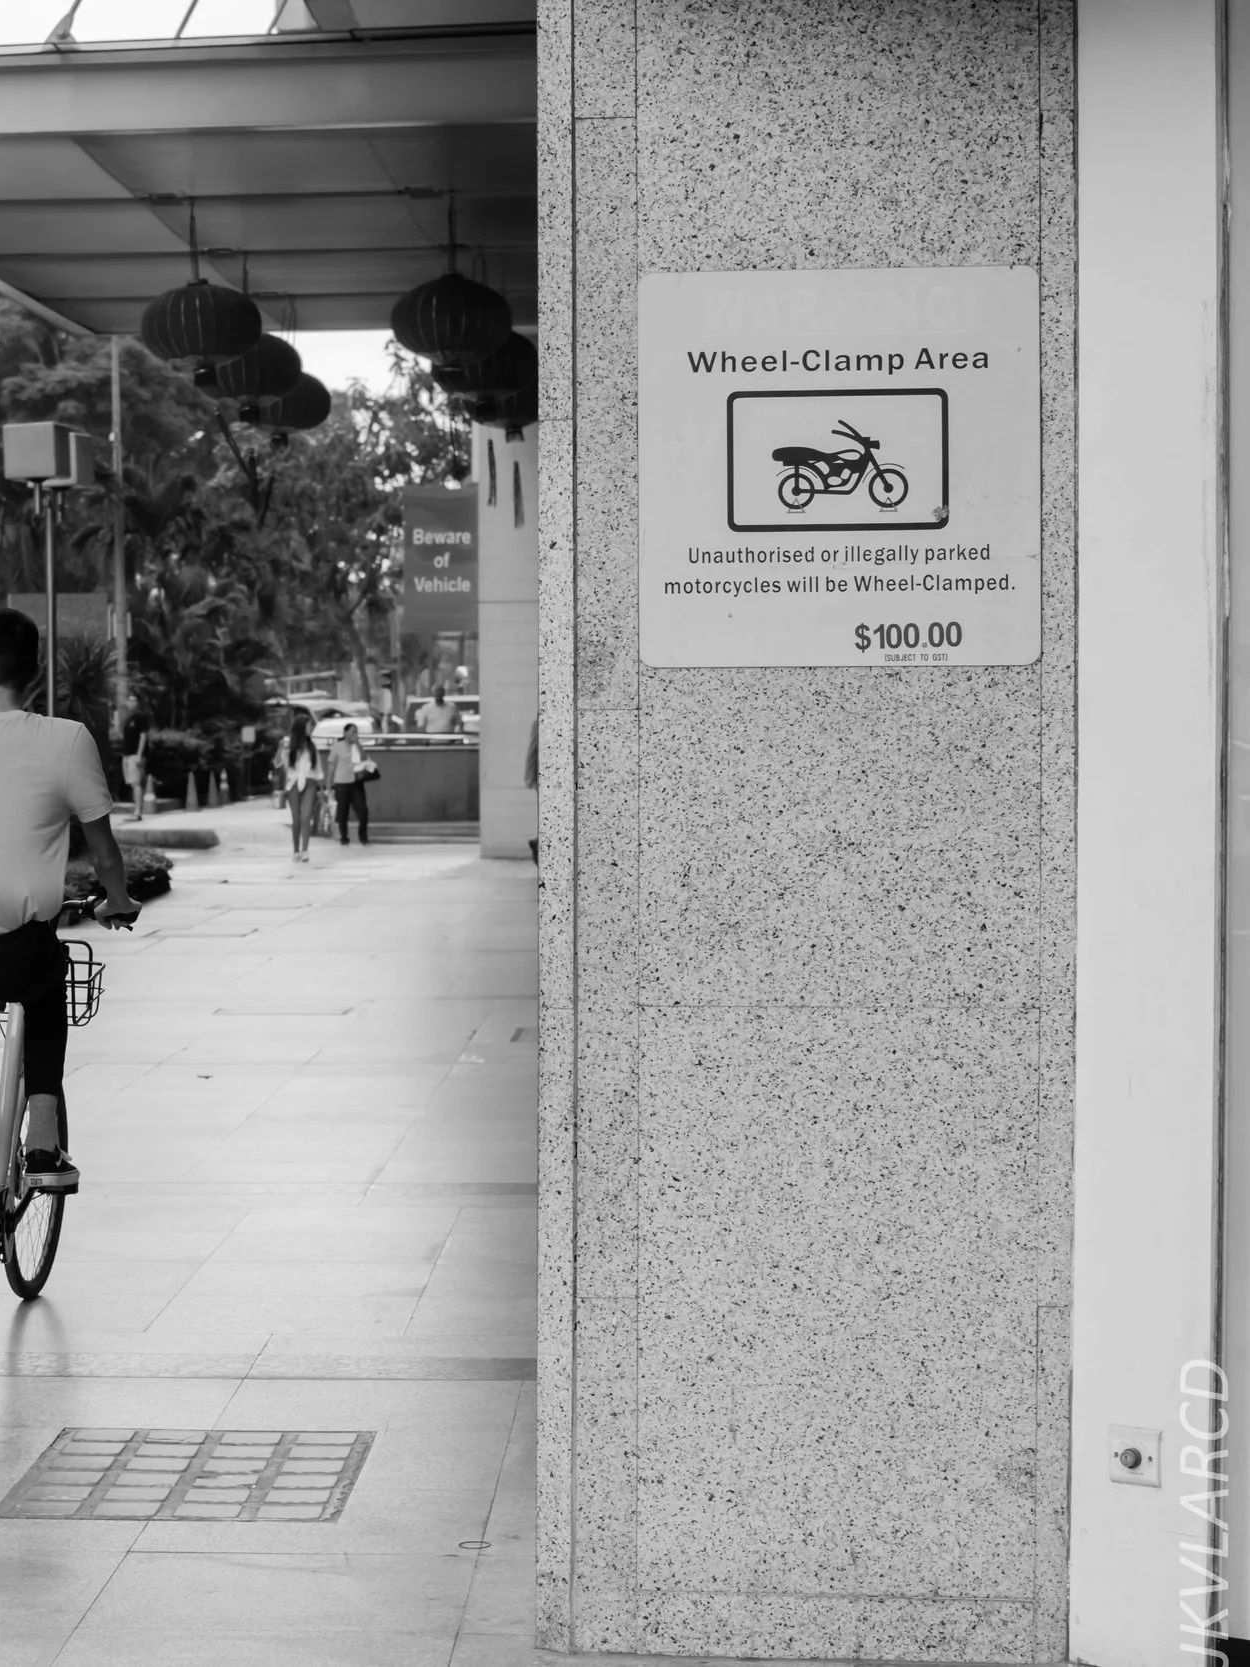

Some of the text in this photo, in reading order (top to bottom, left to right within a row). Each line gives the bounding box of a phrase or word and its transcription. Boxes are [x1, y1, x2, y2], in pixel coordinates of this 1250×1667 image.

[687, 347, 989, 376] Wheel-Clamp Area
[412, 528, 472, 545] Beware
[433, 551, 451, 569] of
[688, 543, 991, 566] Unauthorised or illegally parked
[413, 575, 472, 593] Vehicle
[664, 573, 1016, 598] motorcycles will be Wheel-Clamped.
[854, 621, 963, 653] $100.00
[884, 653, 948, 662] (SUBJECT TO GST)
